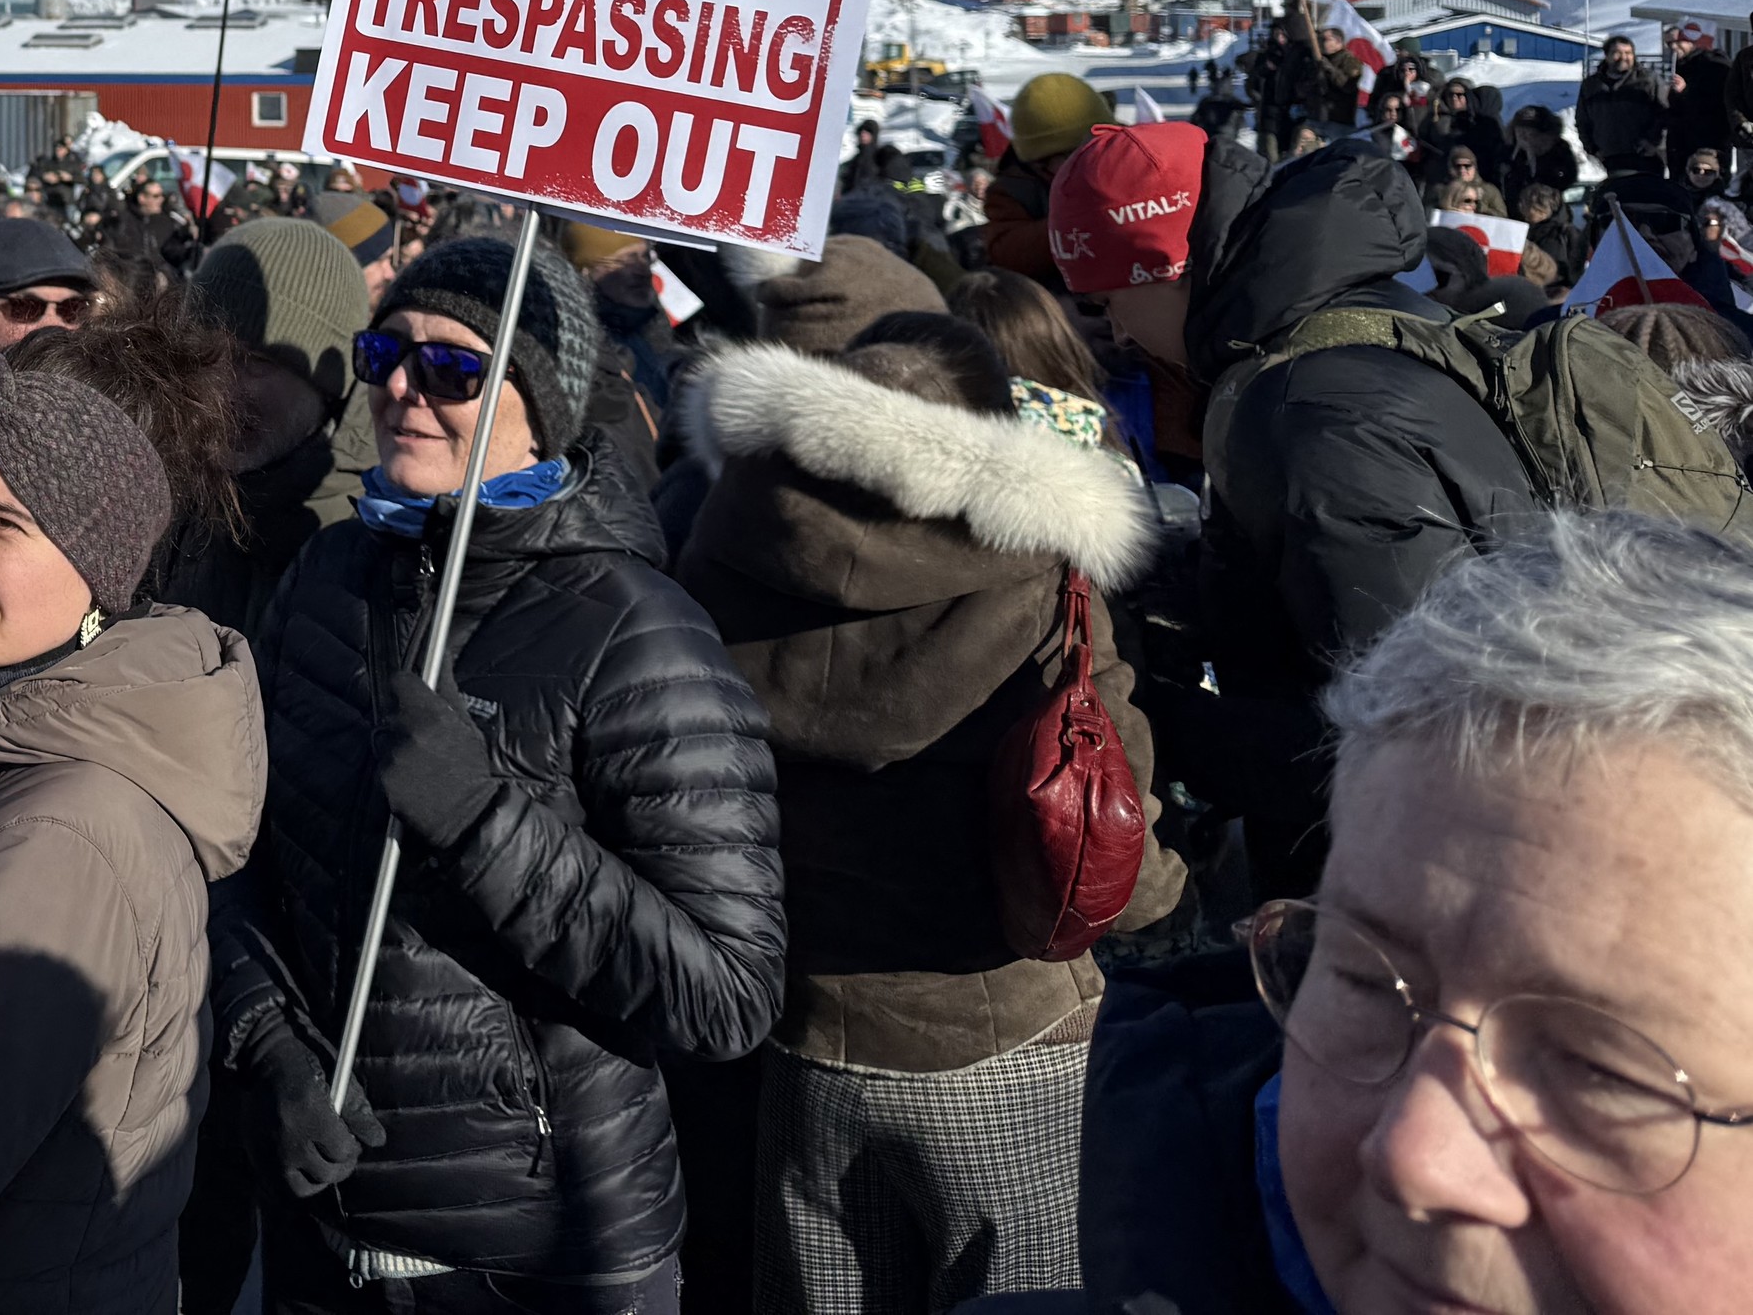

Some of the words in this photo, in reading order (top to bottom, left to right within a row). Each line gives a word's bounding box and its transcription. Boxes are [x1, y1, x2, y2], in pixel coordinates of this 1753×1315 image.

[334, 51, 567, 178] KEEP
[592, 100, 801, 228] OUT
[1108, 196, 1177, 225] VITAL
